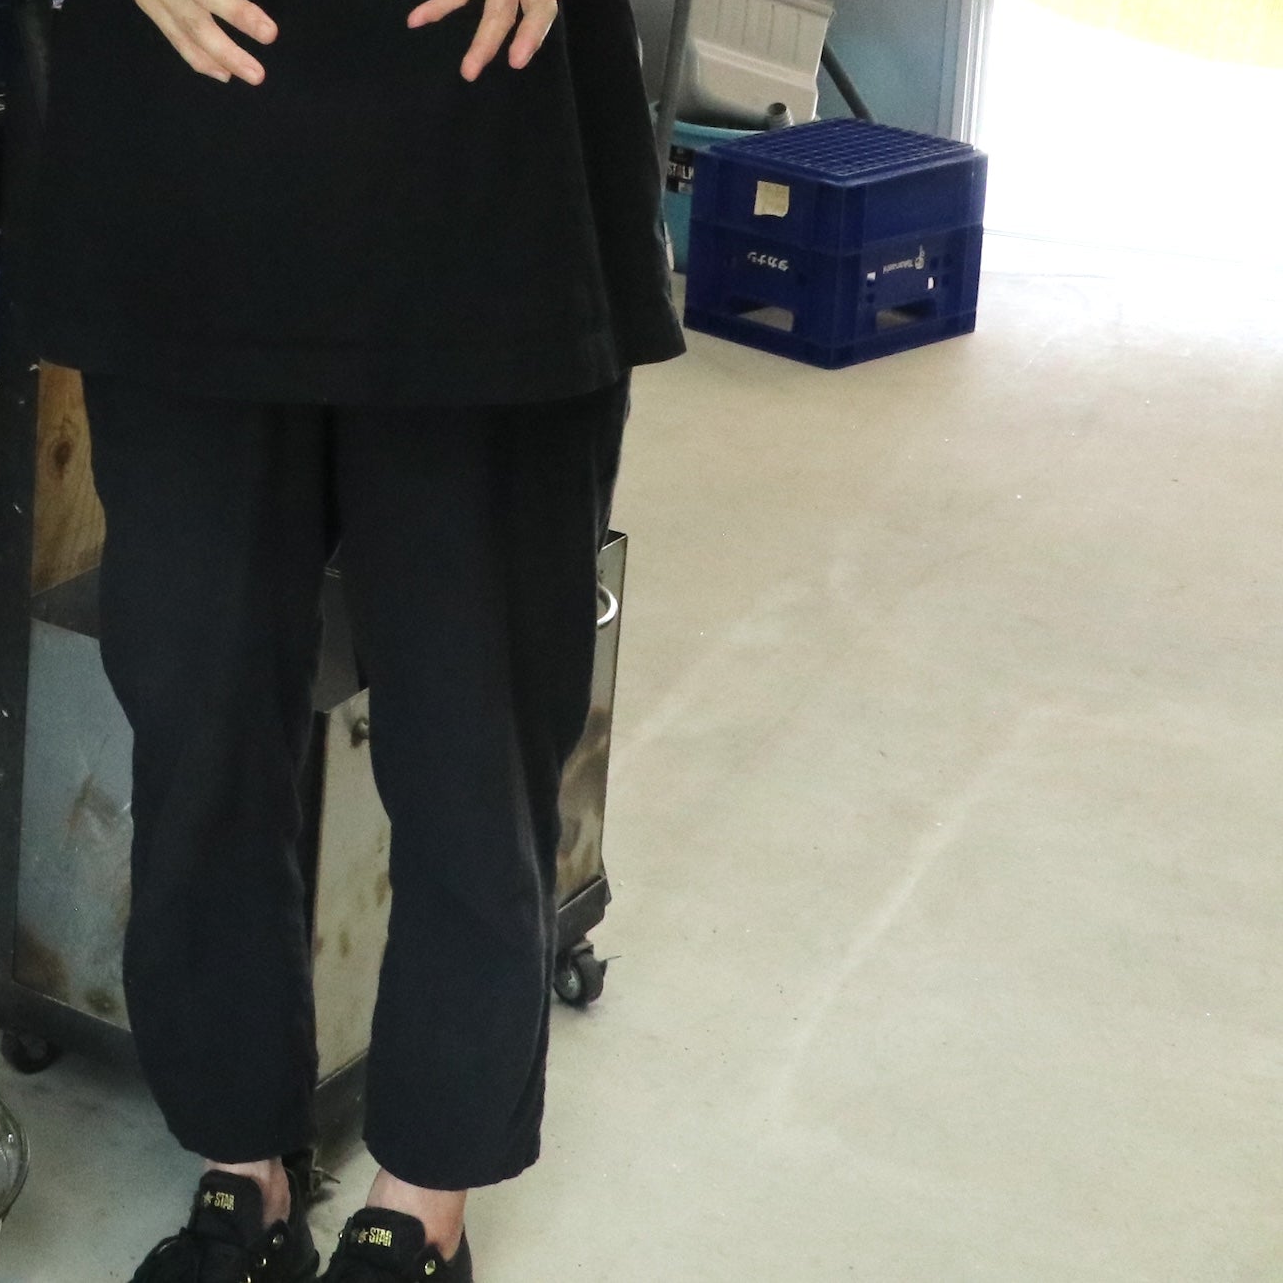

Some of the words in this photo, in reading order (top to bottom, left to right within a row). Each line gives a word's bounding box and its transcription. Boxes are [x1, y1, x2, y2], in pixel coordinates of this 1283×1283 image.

[747, 251, 789, 272] タカナシ
[214, 1191, 235, 1211] STAR
[368, 1226, 392, 1248] STAR
